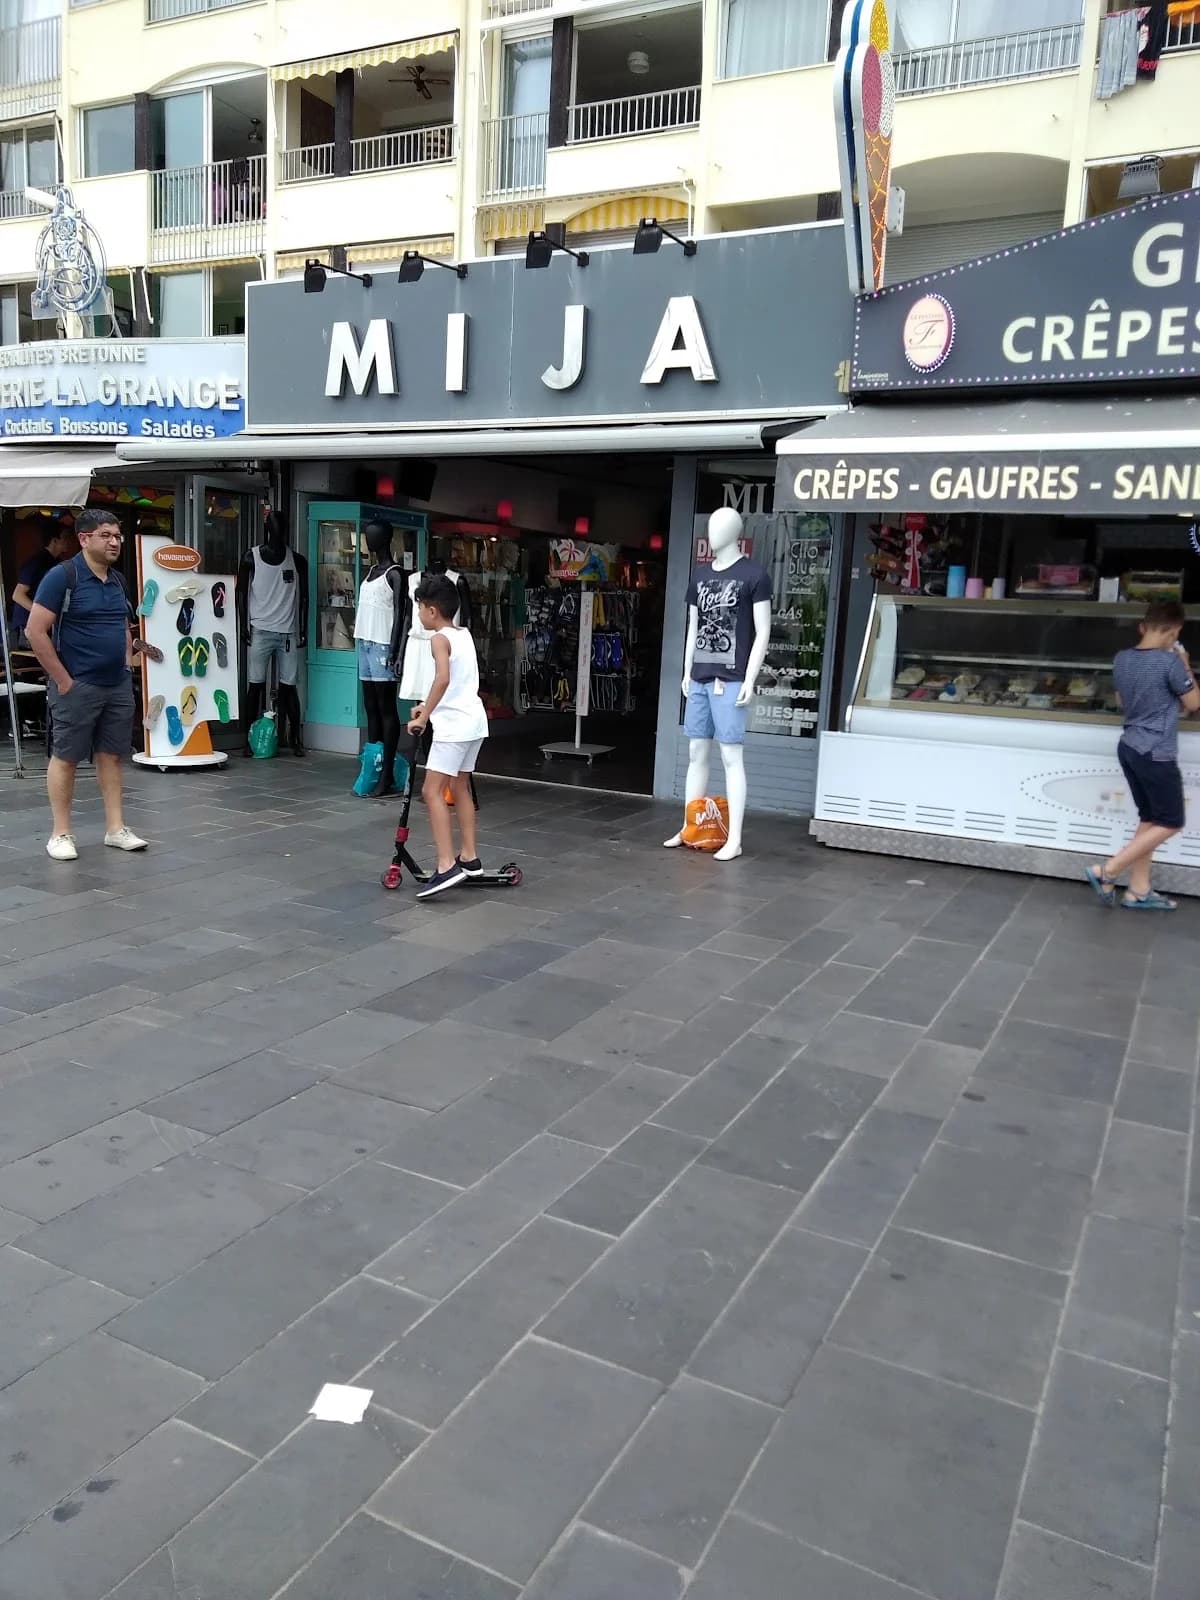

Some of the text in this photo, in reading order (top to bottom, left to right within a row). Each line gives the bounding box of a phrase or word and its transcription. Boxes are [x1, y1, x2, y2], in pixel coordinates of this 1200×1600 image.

[1132, 222, 1200, 287] G
[325, 296, 718, 398] MIJA
[51, 376, 87, 406] LA
[97, 376, 240, 410] GRANGE
[5, 418, 54, 435] Cocktails
[59, 416, 128, 435] Boissons
[140, 418, 216, 438] Salades
[793, 460, 899, 500] CRÊPES
[930, 465, 1079, 500] GAUFRES
